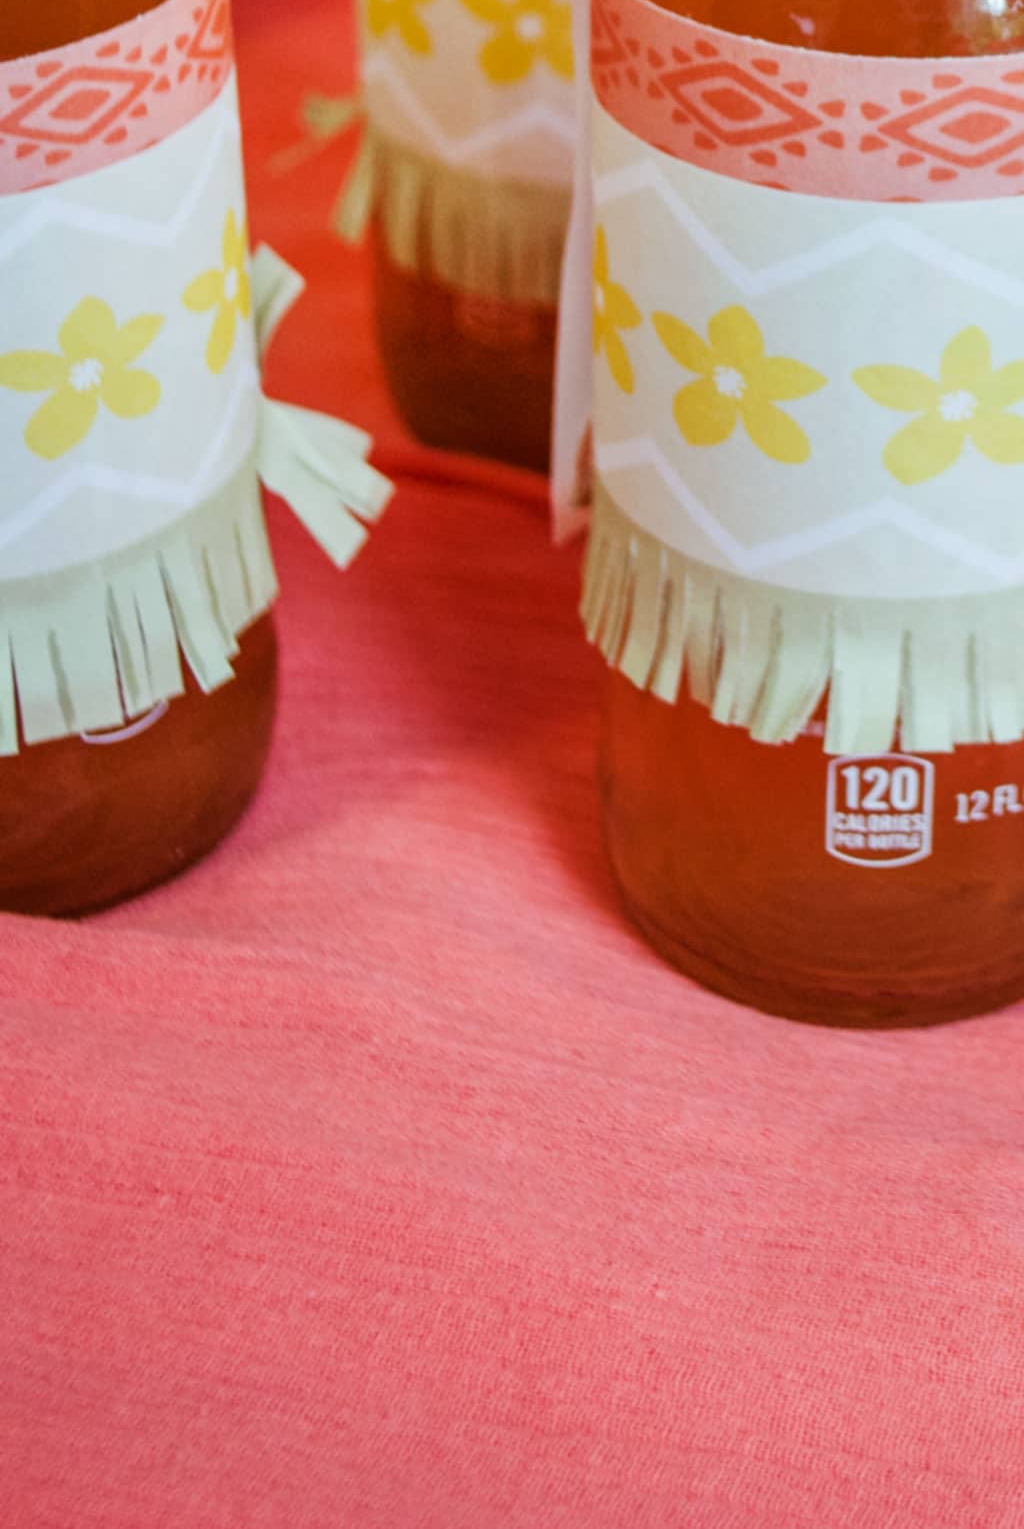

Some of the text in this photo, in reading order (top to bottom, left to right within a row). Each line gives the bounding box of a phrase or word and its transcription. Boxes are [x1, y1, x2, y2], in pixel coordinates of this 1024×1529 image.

[841, 765, 920, 811] 120
[954, 791, 990, 823] 12
[992, 783, 1024, 816] FL
